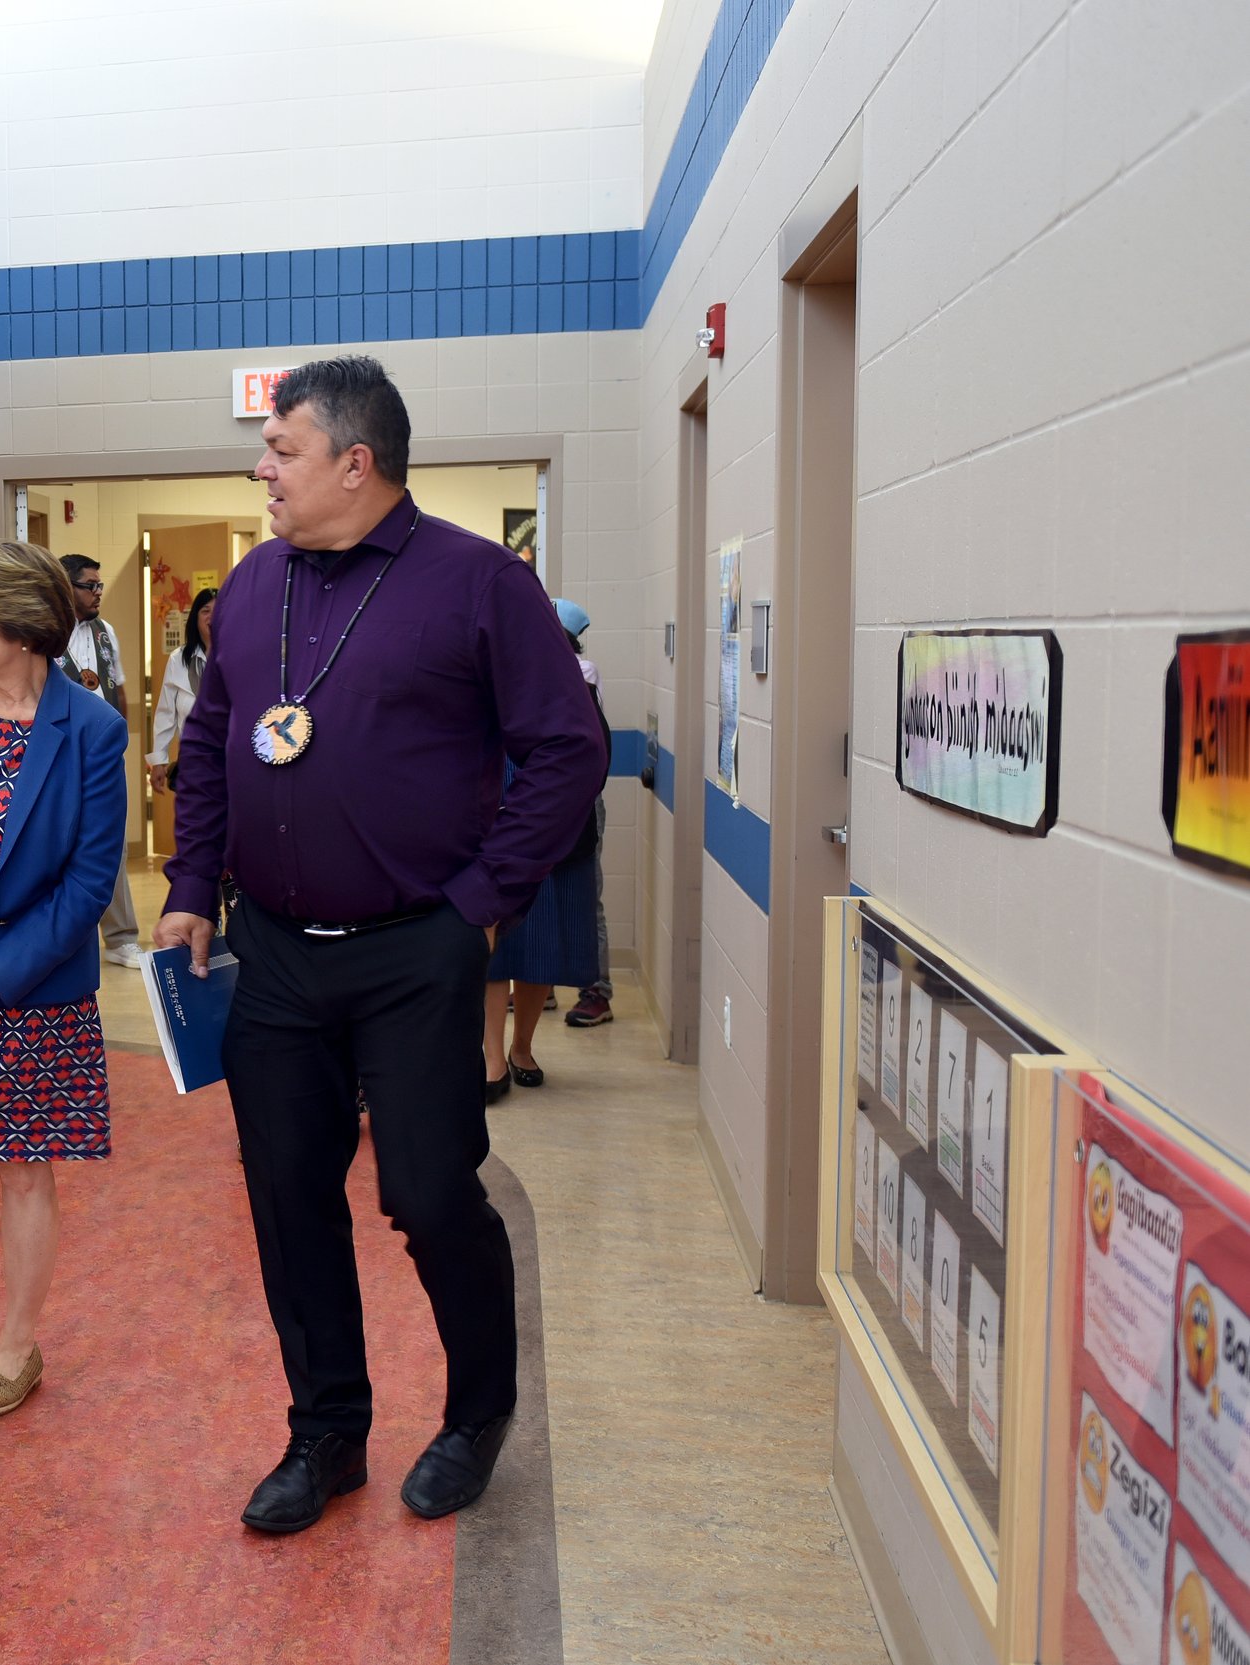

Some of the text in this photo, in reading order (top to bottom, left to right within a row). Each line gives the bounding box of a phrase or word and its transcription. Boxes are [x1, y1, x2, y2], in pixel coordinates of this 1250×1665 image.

[888, 994, 896, 1038] 9
[914, 1018, 923, 1067] 2
[948, 1051, 957, 1100] 7
[986, 1088, 993, 1141] 1
[862, 1145, 869, 1186] 3
[882, 1174, 894, 1225] 10
[910, 1215, 918, 1263] 8
[978, 1315, 988, 1369] 5
[1109, 1440, 1167, 1537] Zegizi
